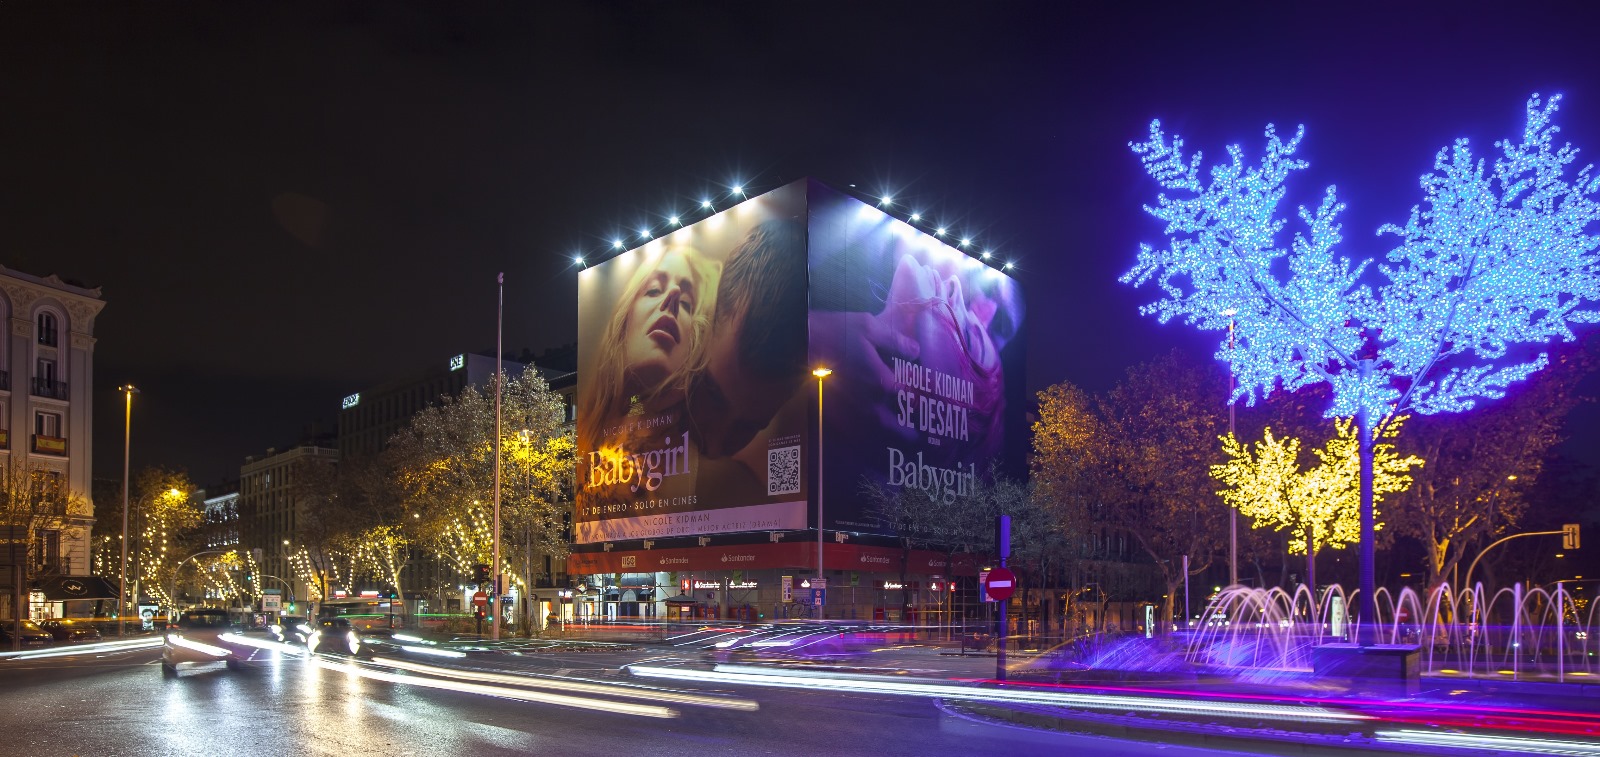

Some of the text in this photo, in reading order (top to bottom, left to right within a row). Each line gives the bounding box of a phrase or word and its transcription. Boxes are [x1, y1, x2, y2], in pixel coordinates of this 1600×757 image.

[935, 371, 974, 405] KIDMAN
[897, 390, 914, 428] SE
[637, 415, 672, 430] KDMAN
[588, 431, 690, 492] Babygirl
[887, 447, 975, 505] Babygirl
[592, 506, 600, 514] DE
[603, 504, 627, 514] ENERO
[634, 501, 655, 510] SOLO
[658, 499, 669, 508] EN
[672, 496, 697, 506] CINES
[644, 513, 710, 526] NICOLE KIDMAN
[728, 554, 755, 562] Santander
[866, 556, 890, 564] Santander
